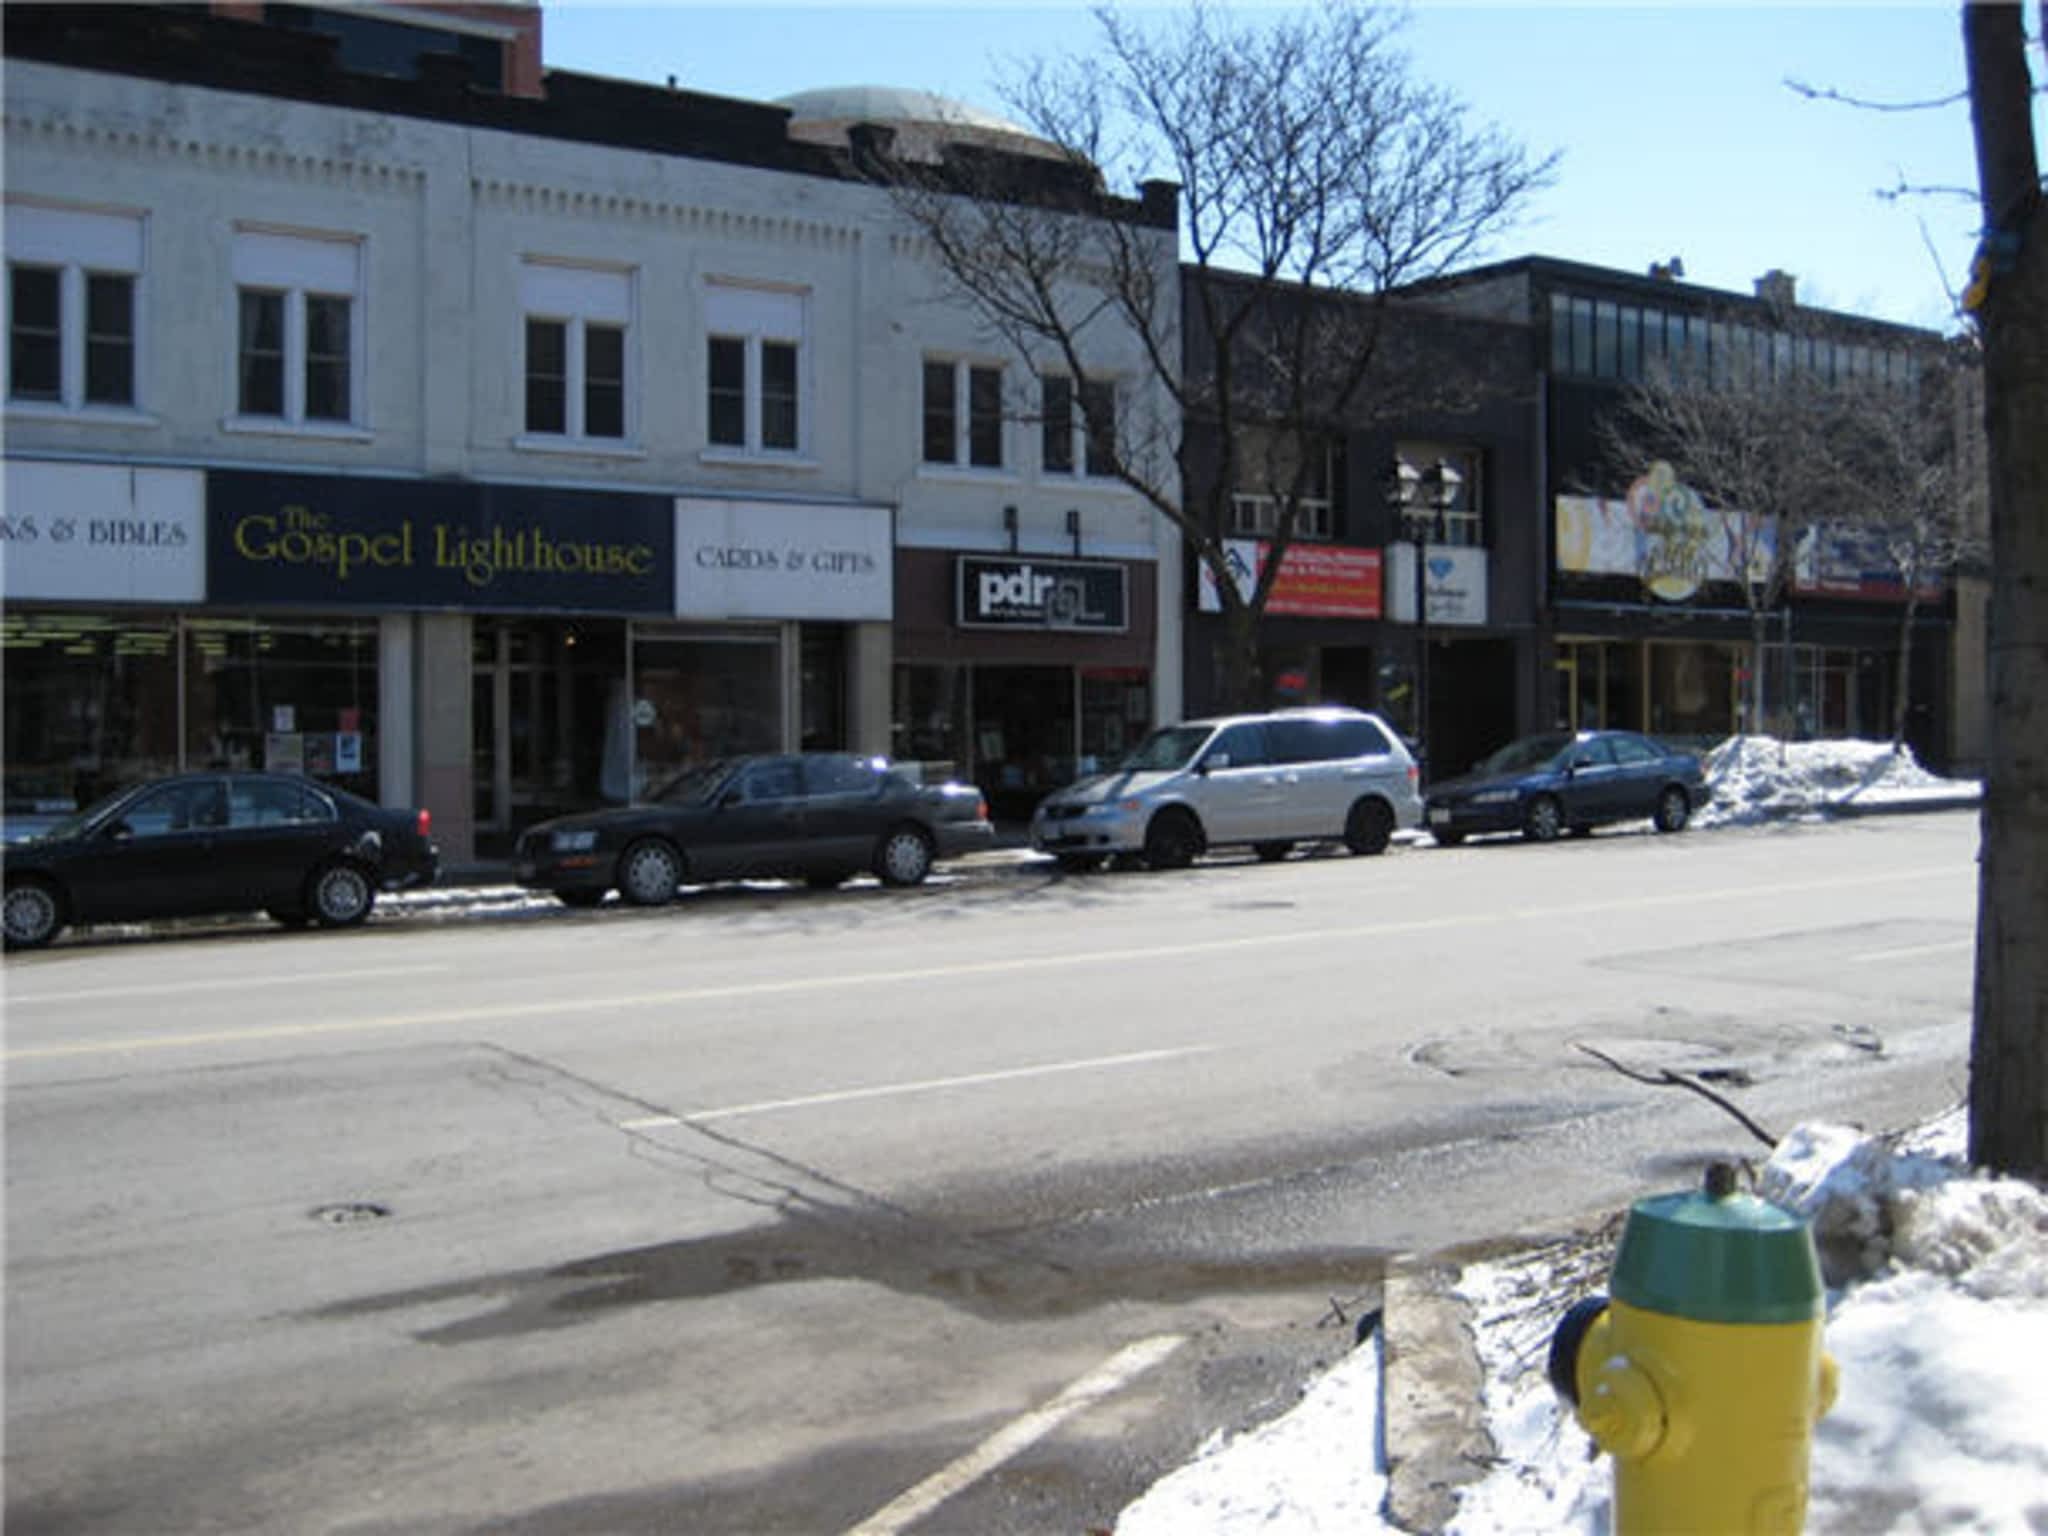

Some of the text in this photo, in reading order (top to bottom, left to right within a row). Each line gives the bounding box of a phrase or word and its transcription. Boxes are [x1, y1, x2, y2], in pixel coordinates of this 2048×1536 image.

[284, 506, 328, 528] The
[50, 518, 77, 543] &
[90, 518, 188, 546] BIBLES
[234, 517, 653, 586] Gospel Lighthouse
[695, 547, 876, 574] CARDS & GIFTS
[979, 565, 1054, 616] pdr
